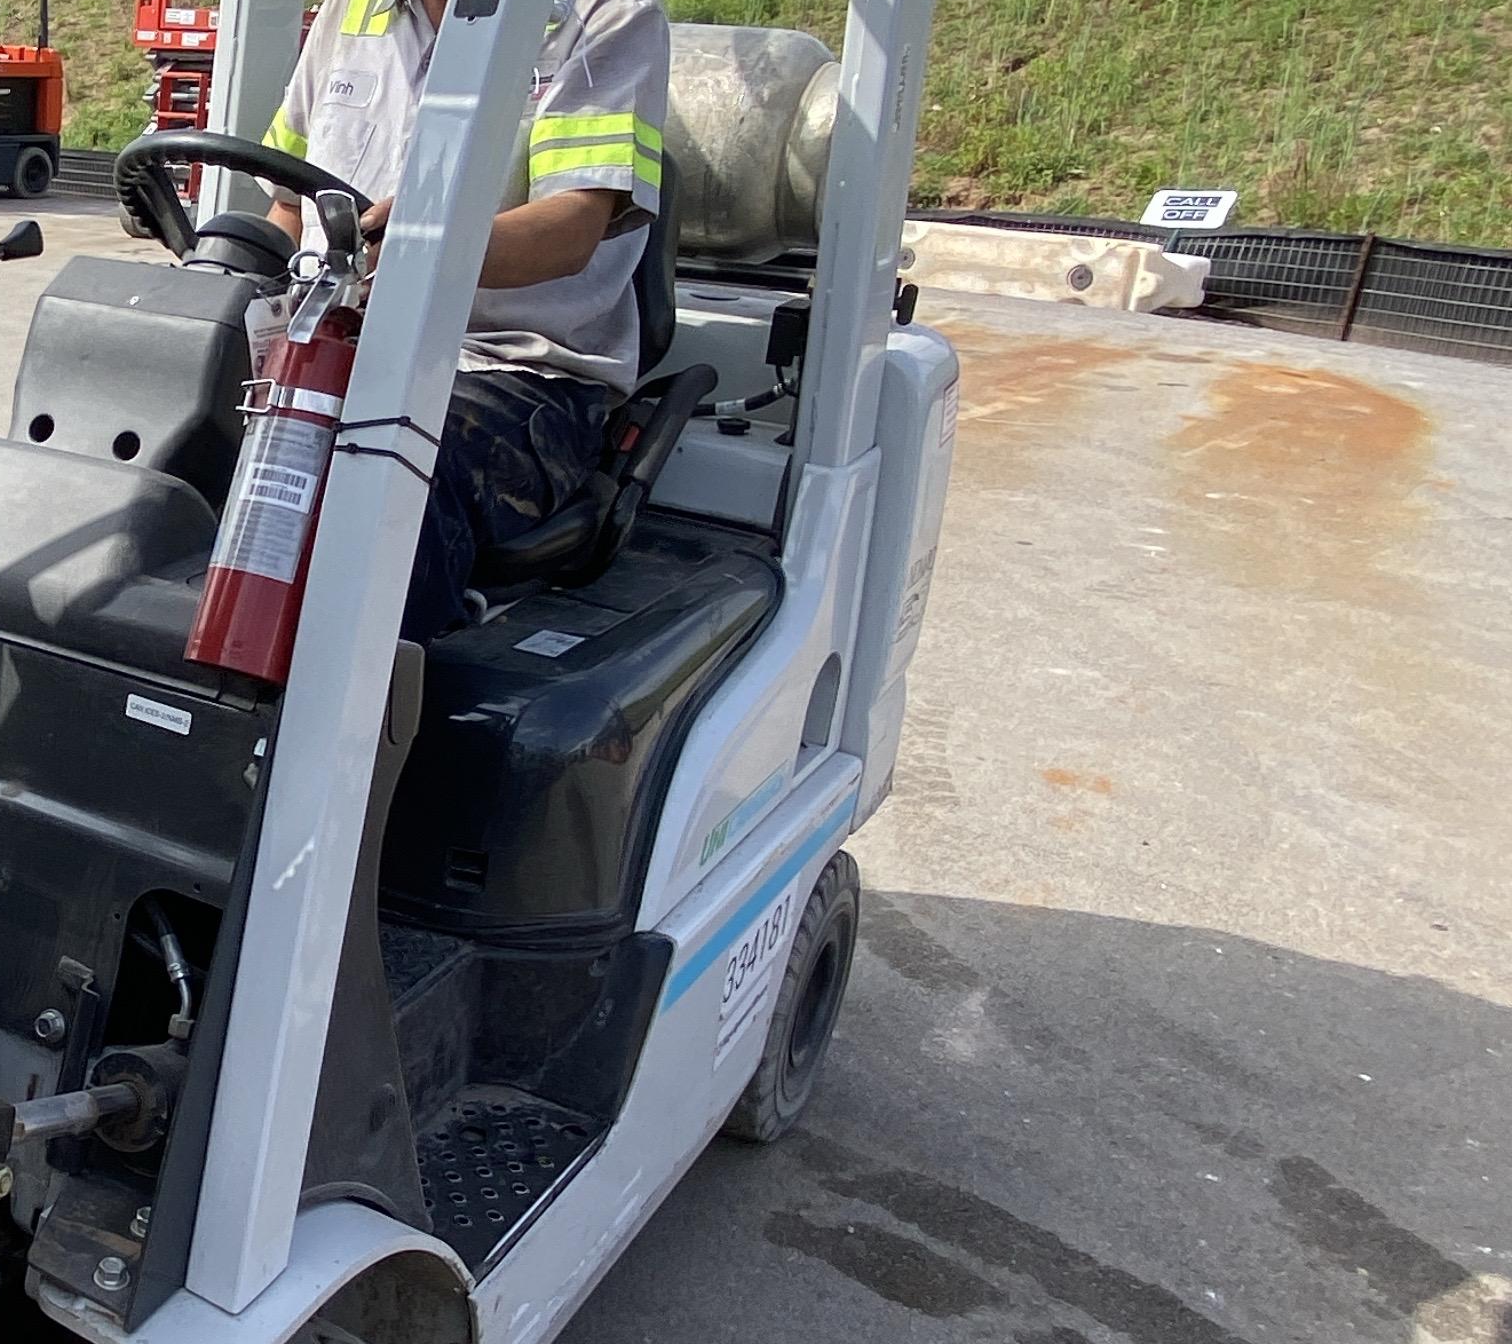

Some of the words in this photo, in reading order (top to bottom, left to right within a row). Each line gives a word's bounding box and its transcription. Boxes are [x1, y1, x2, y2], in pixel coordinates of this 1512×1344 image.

[329, 80, 355, 97] Vinh
[1164, 197, 1221, 207] CALL
[1162, 209, 1208, 221] OFF
[722, 894, 792, 1004] 334181
